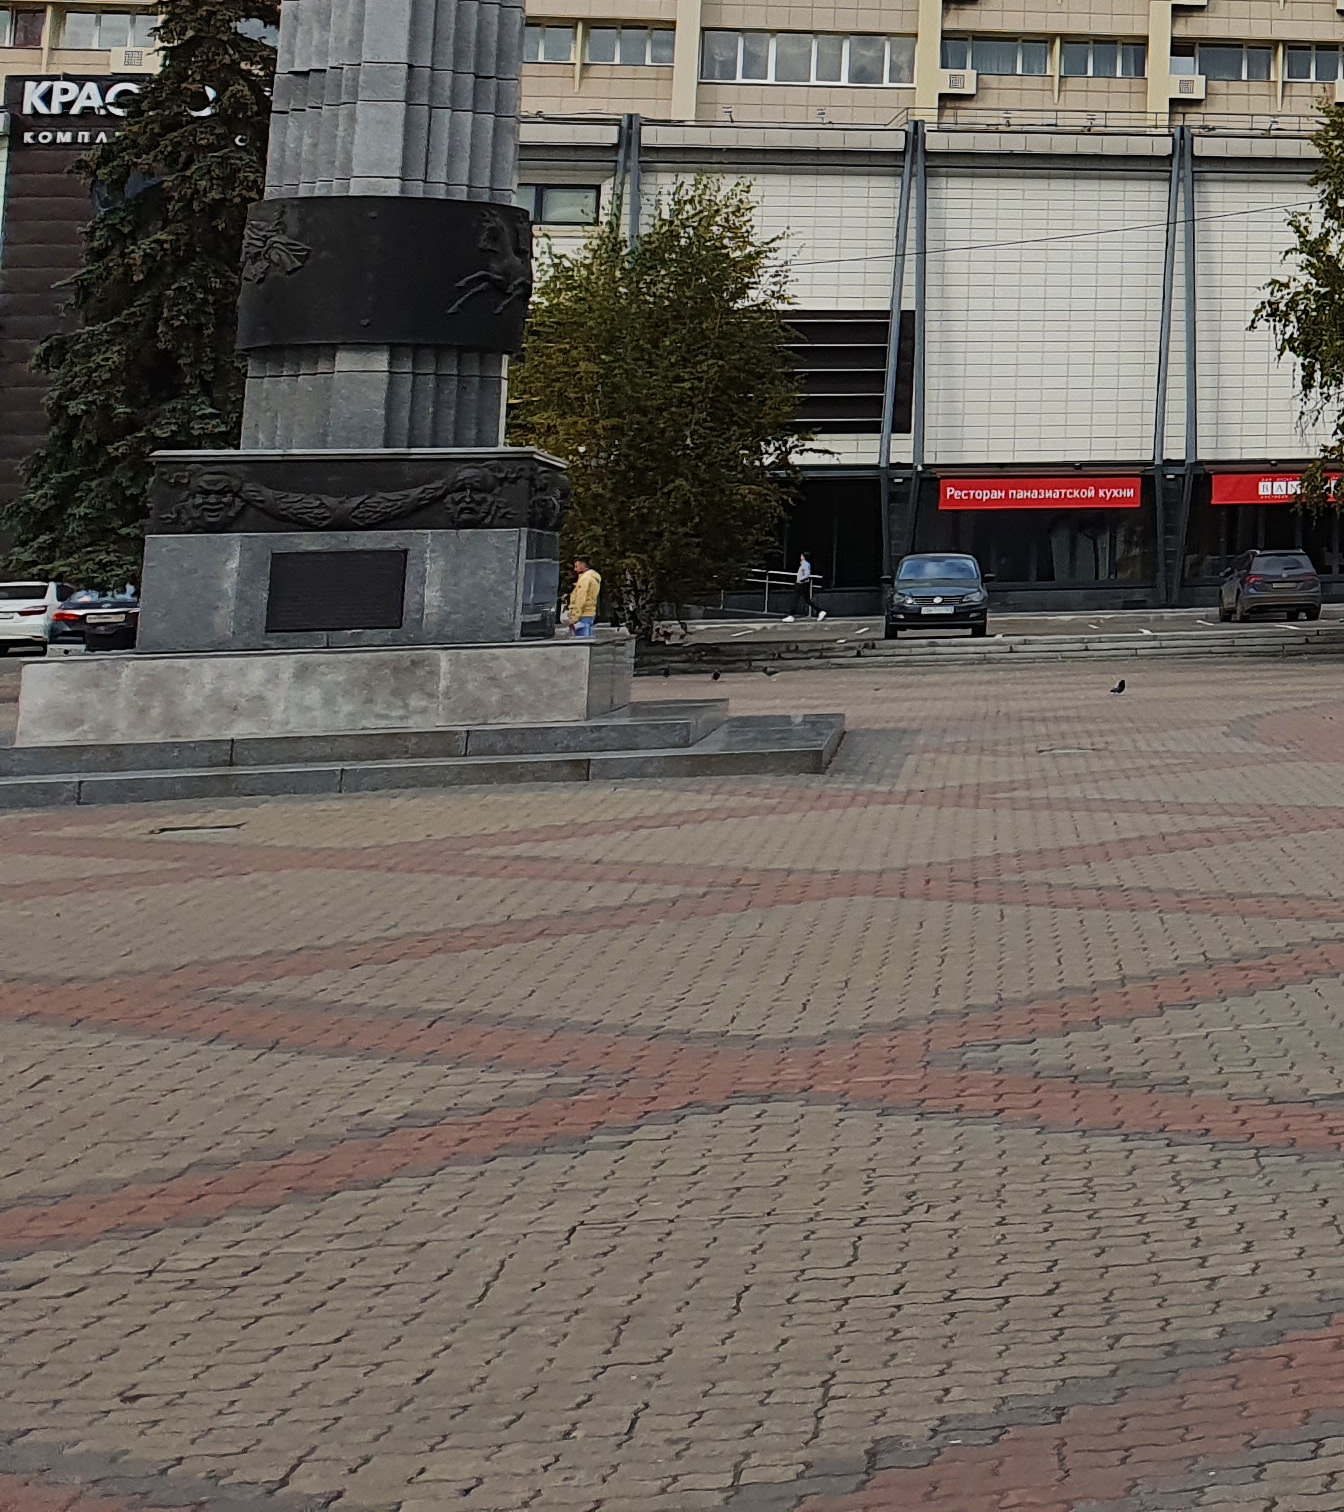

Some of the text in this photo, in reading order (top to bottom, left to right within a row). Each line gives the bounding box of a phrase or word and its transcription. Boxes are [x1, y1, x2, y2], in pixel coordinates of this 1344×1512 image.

[23, 131, 124, 144] КОМПЛ
[946, 486, 1134, 502] Ресторан паназиатской кухни
